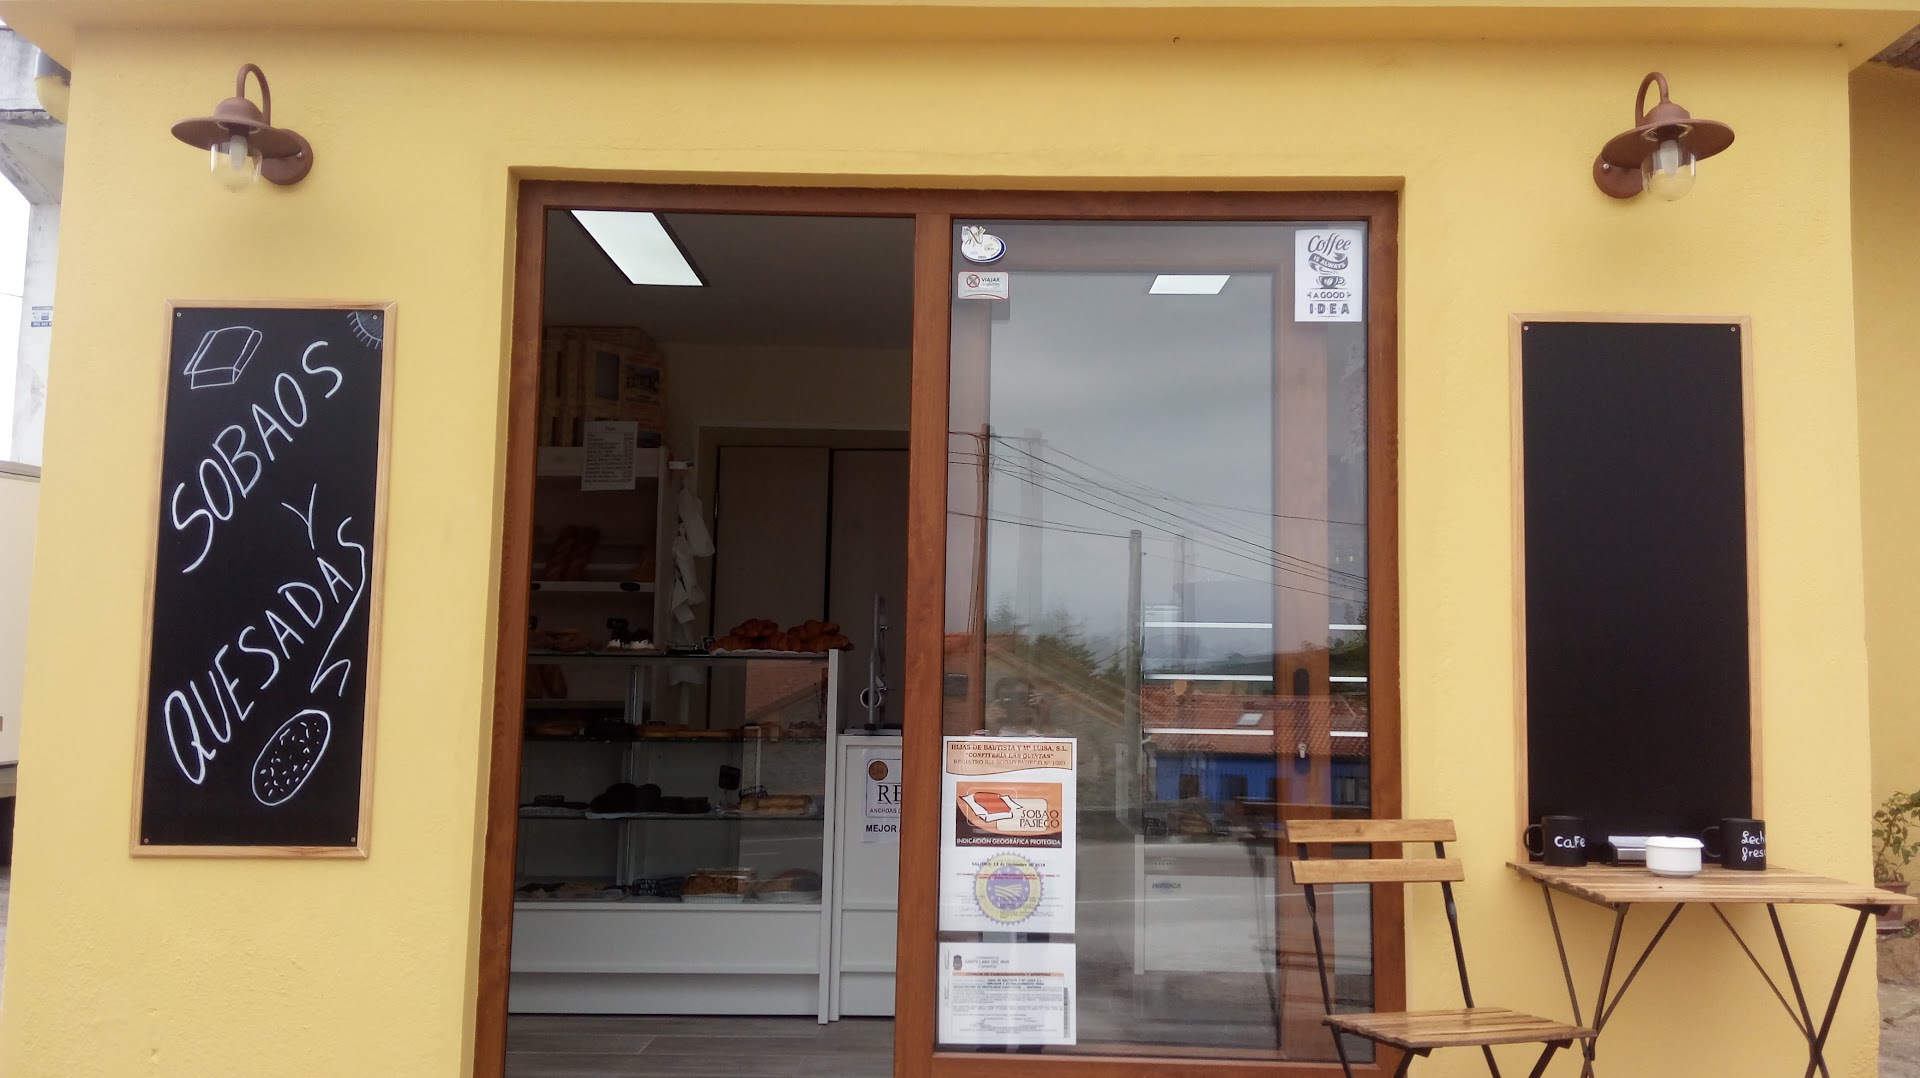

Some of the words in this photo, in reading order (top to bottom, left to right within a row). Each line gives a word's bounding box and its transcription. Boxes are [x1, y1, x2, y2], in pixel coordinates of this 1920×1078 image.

[1307, 233, 1351, 255] Coffee
[1320, 260, 1346, 270] ALWAYS
[1320, 291, 1345, 299] GOOD
[1309, 303, 1350, 314] IDEA
[172, 340, 343, 573] SOBAOS
[281, 482, 317, 550] Y
[164, 516, 365, 785] QUESADAS
[1020, 809, 1059, 819] SOBAO
[865, 824, 897, 832] MEJOR
[1019, 818, 1060, 828] PASIEGO
[956, 836, 992, 844] INDICACIÓN
[991, 836, 1029, 845] GEOGRÁFICA
